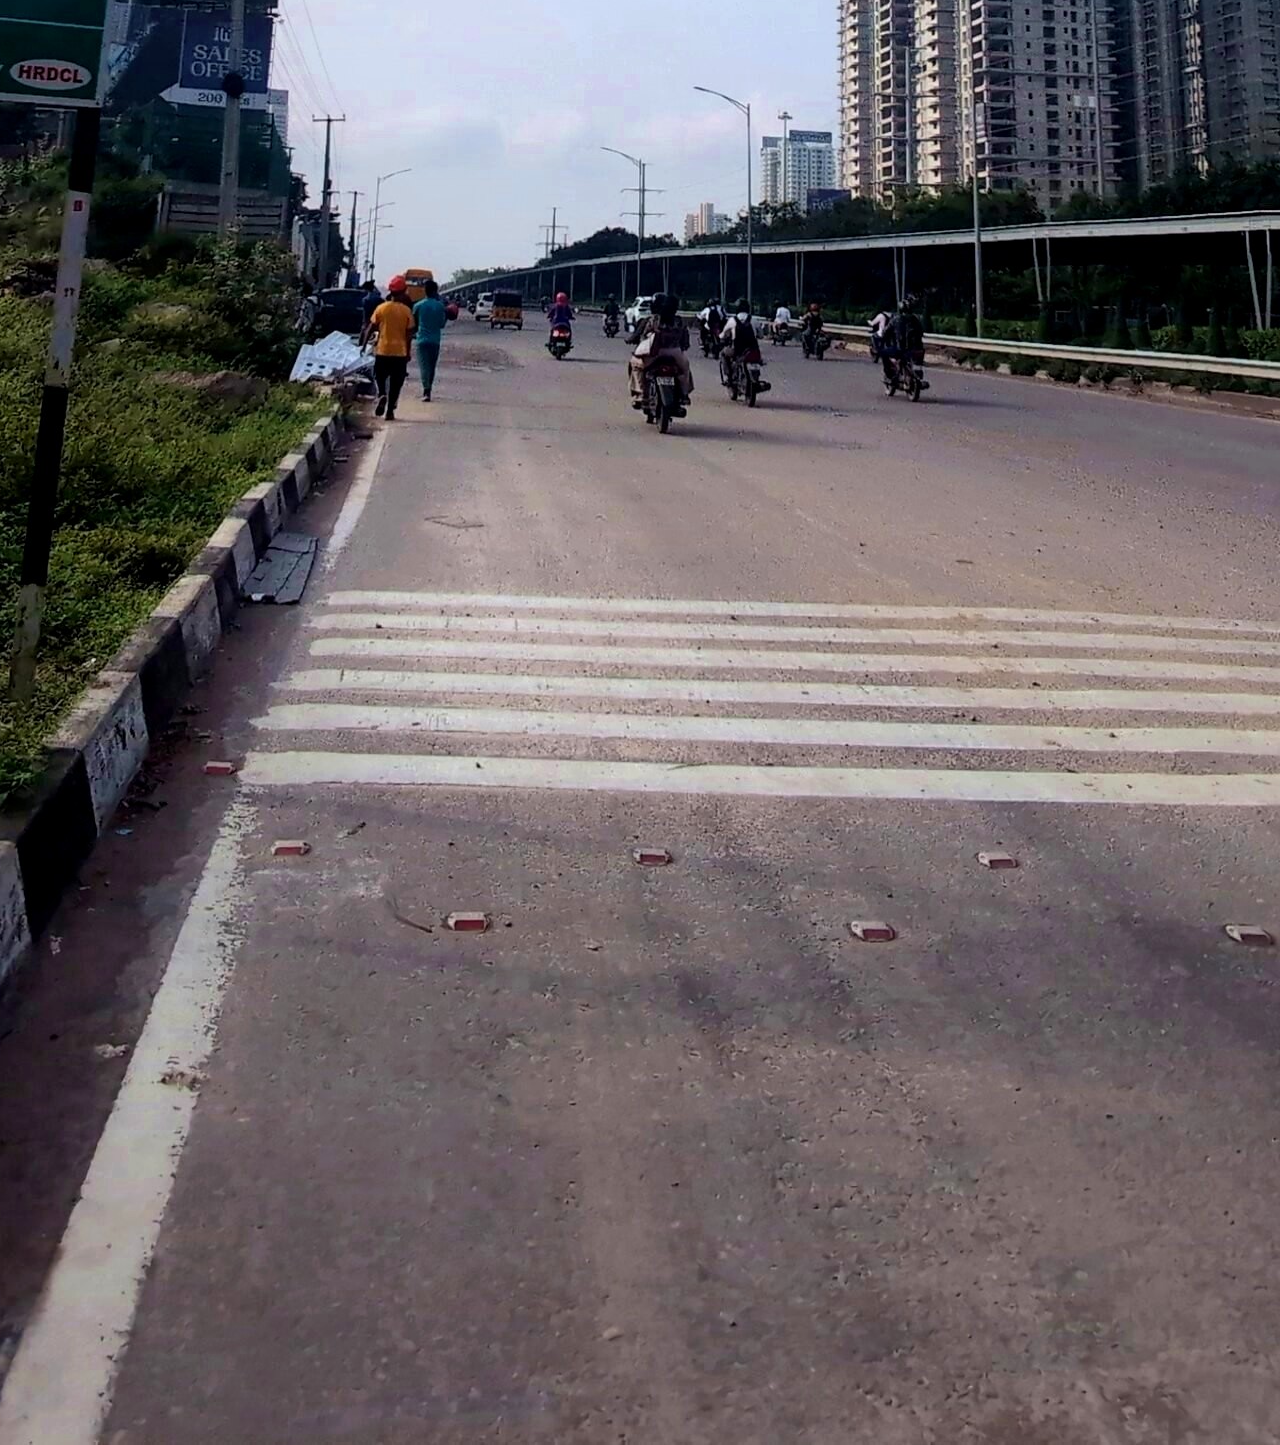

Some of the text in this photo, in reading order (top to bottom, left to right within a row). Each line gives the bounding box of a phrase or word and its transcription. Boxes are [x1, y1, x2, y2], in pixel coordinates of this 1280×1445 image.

[17, 64, 84, 84] HRDCL
[191, 60, 263, 82] OFFCE
[198, 92, 223, 103] 200
